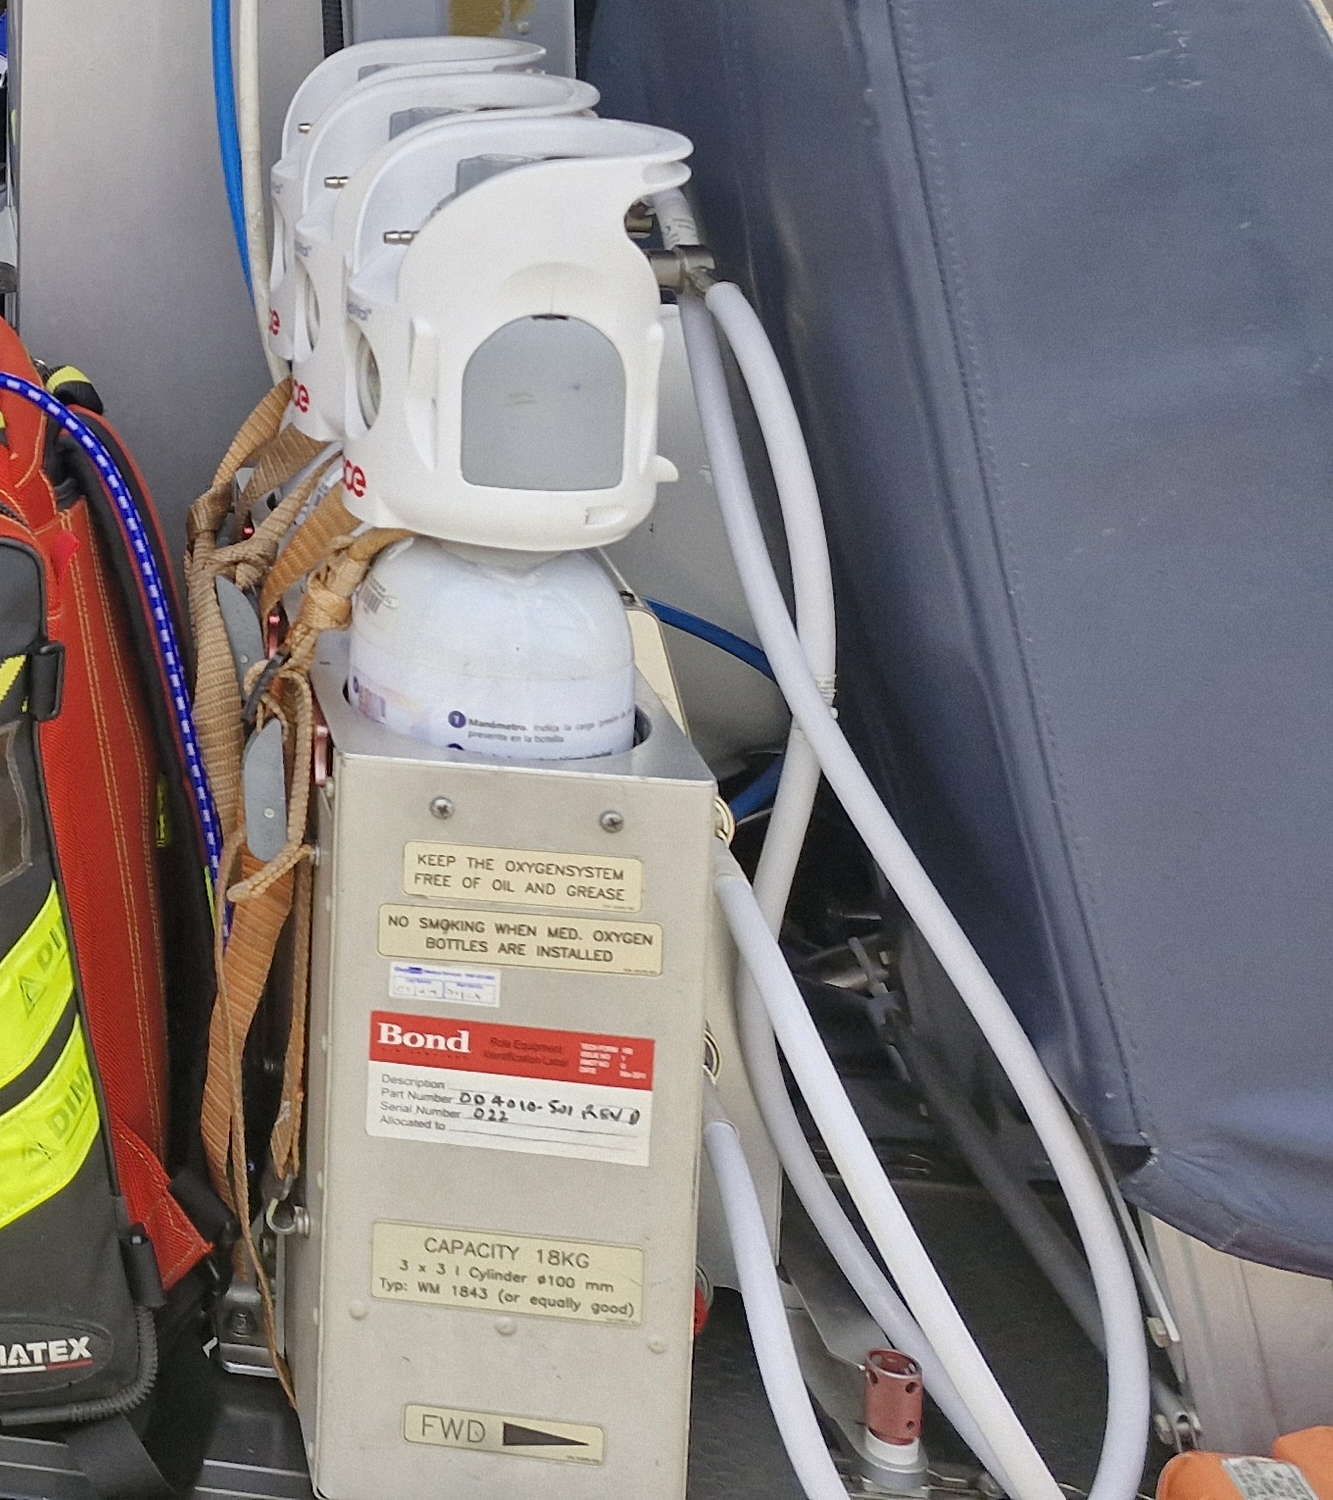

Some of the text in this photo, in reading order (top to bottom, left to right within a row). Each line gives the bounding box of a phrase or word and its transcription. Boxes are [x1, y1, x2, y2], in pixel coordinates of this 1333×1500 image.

[416, 853, 625, 881] KEEP THE OXYGENSYSTEM
[413, 872, 625, 902] FREE OF OIL AND GREASE
[388, 915, 653, 946] NO SMOKING WHEN MED. OXYGEN
[425, 936, 613, 963] BOTTLES ARE INSTALLED
[377, 1022, 471, 1054] Bond
[381, 1074, 445, 1090] Description
[381, 1088, 453, 1104] Part Number
[379, 1114, 446, 1130] Allocated to
[380, 1102, 461, 1118] Serial Number
[473, 1108, 509, 1123] 022
[423, 1236, 591, 1270] CAPACITY 18KG
[399, 1258, 410, 1272] 3
[417, 1264, 427, 1273] x
[435, 1262, 447, 1276] 3
[469, 1266, 528, 1285] Cylinder
[585, 1280, 615, 1294] mm
[379, 1276, 635, 1319] Typ: WM 1843 (or equally good)
[421, 1414, 487, 1443] FWD
